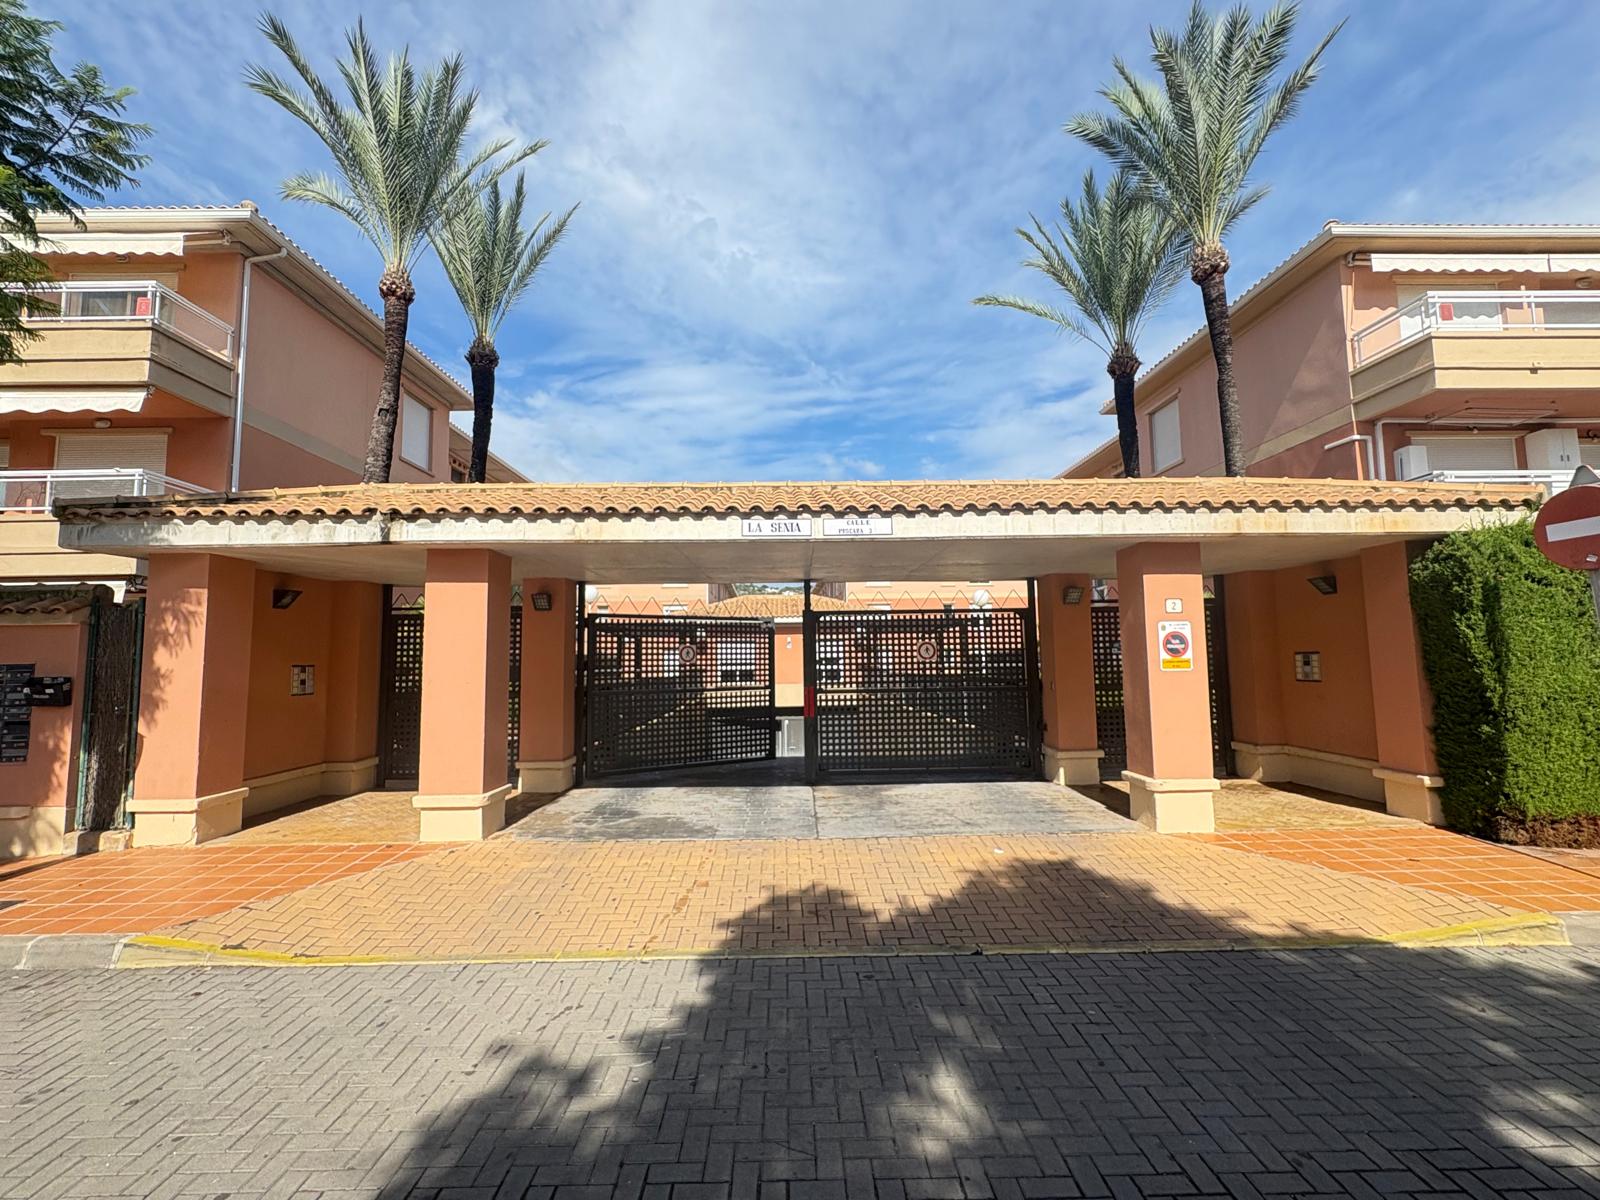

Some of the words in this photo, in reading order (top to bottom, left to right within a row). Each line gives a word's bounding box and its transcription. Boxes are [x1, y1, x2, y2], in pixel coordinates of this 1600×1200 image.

[748, 522, 762, 533] LA
[770, 522, 801, 533] SENIA
[1171, 601, 1177, 611] 2
